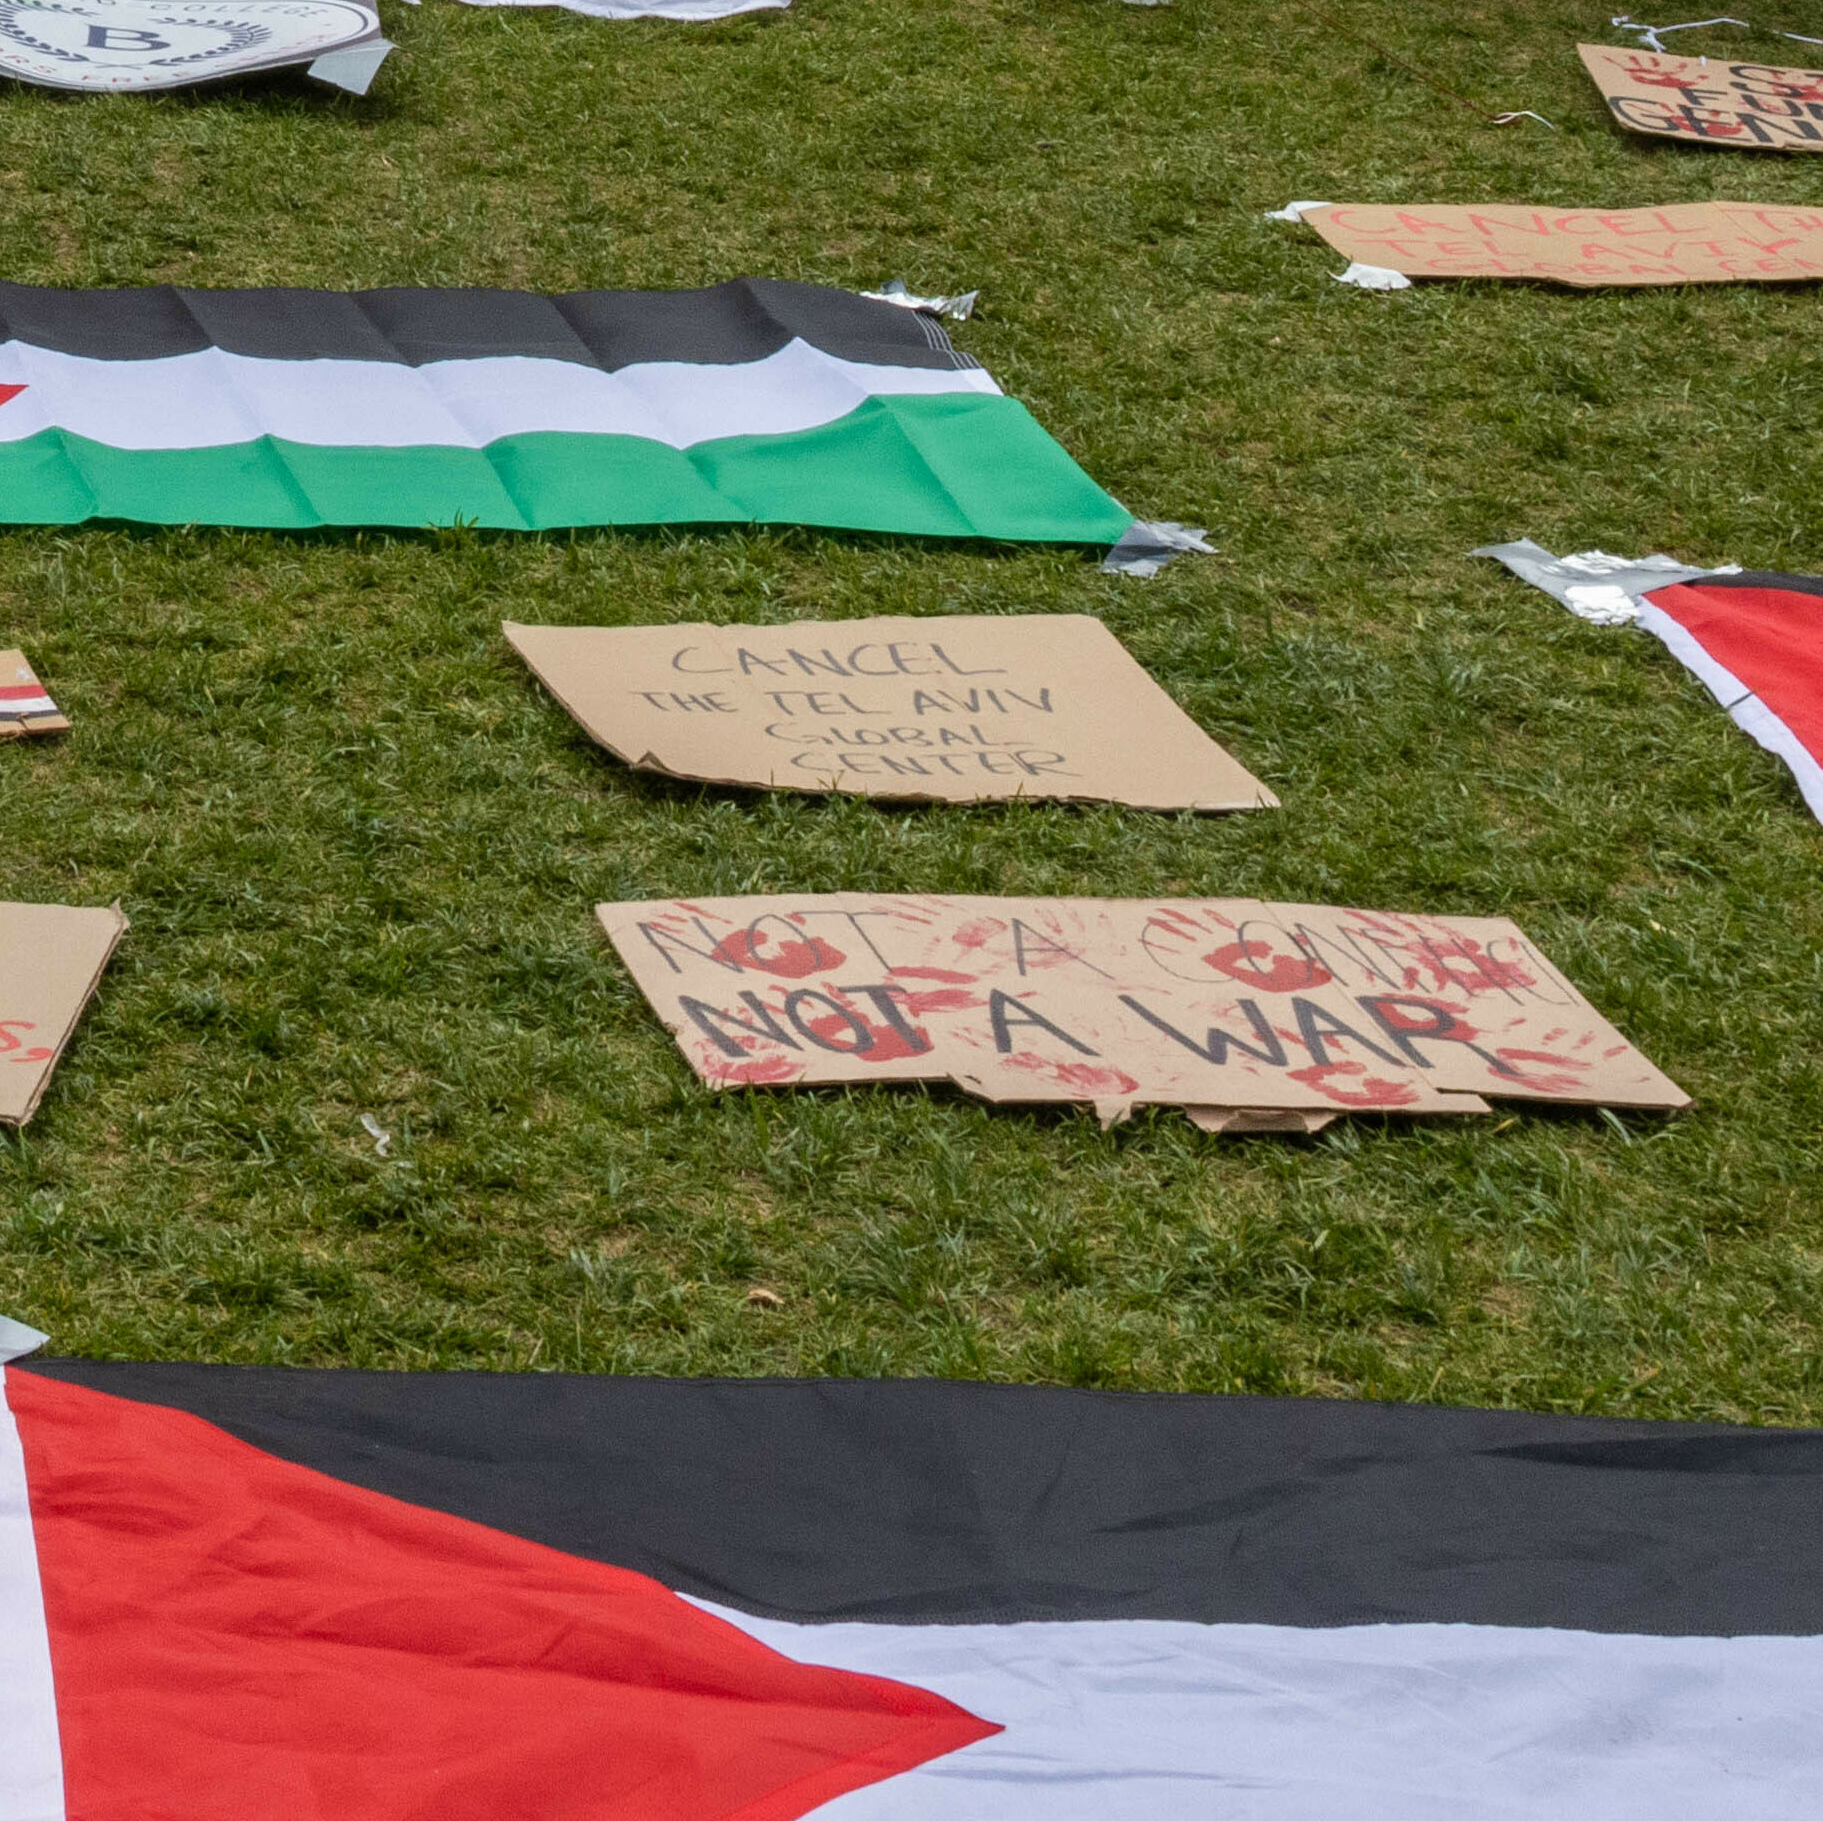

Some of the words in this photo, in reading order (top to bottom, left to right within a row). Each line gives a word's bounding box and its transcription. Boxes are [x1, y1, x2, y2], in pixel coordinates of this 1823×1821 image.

[150, 2, 333, 20] COLLEGE
[85, 23, 172, 52] B
[1328, 208, 1711, 237] CANCEL
[1355, 238, 1530, 258] TEL
[1579, 236, 1803, 261] AVIV
[1424, 258, 1689, 276] GLOBAL
[670, 641, 1010, 677] CANCEL
[629, 690, 741, 714] THE
[763, 689, 893, 716] TEL
[912, 686, 1055, 716] AVIV
[763, 721, 1035, 747] GLOBAL
[789, 748, 1084, 778] CENTER
[638, 910, 905, 977] NOT
[1012, 916, 1118, 978] A
[678, 984, 932, 1059] NOT
[987, 986, 1100, 1057] A
[1116, 992, 1522, 1077] WAR
